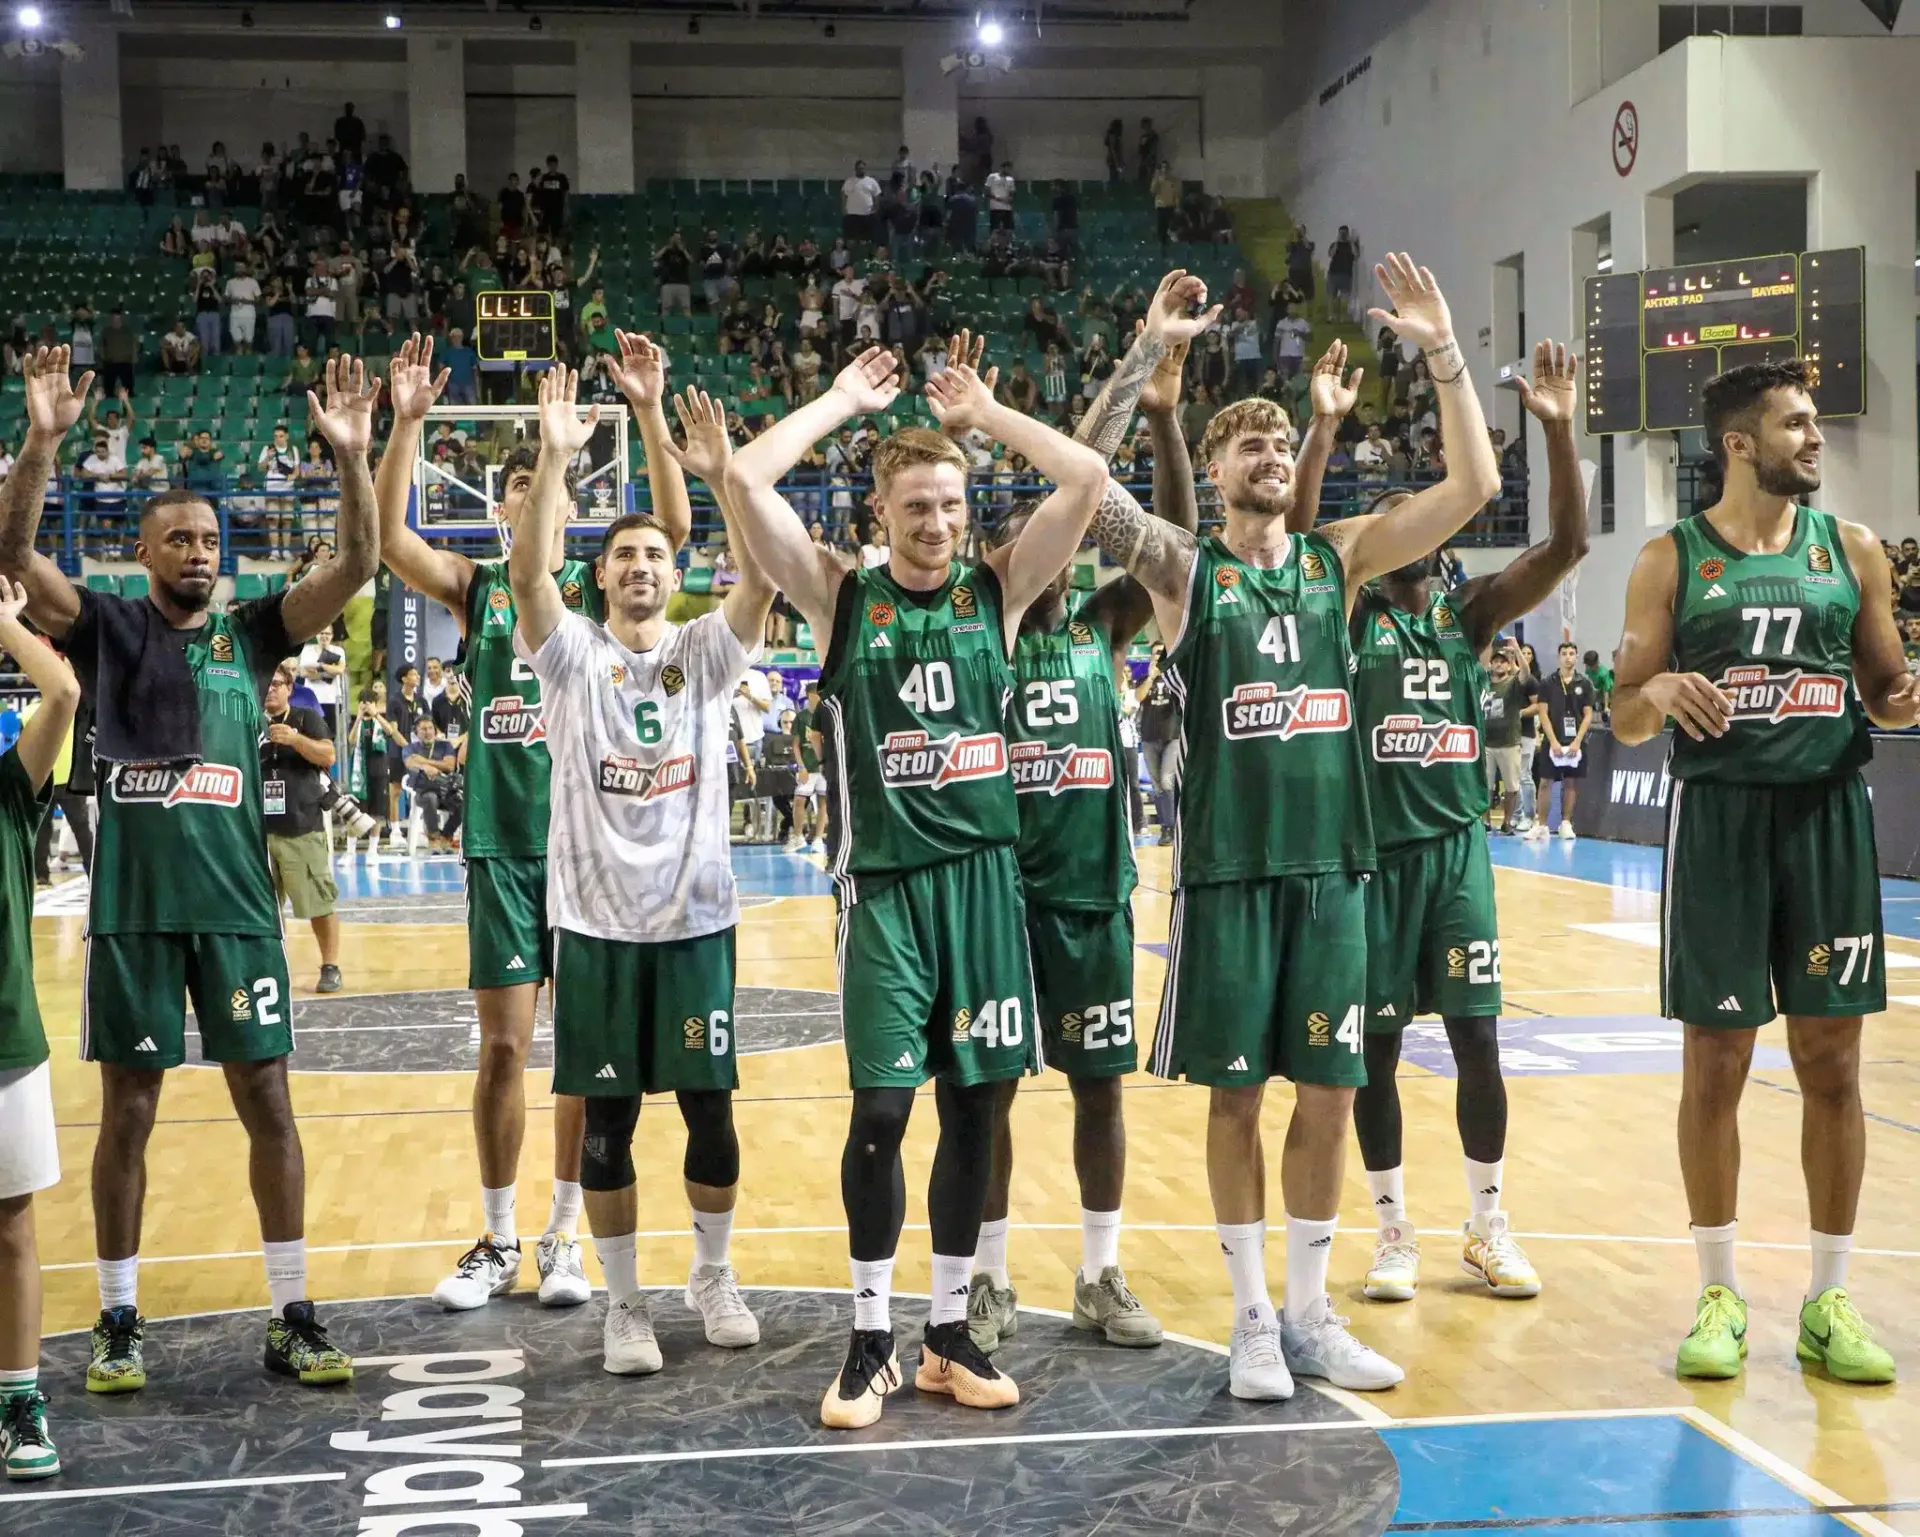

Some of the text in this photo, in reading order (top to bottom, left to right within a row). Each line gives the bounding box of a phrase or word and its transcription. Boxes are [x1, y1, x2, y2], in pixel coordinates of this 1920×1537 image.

[1644, 294, 1703, 309] AKTOR PAO
[1751, 284, 1794, 298] BAYERN
[1702, 327, 1736, 339] Bodet
[951, 623, 985, 634] oneteam
[1256, 614, 1301, 664] 41
[1741, 608, 1803, 656] 77
[898, 661, 956, 713] 40
[1240, 686, 1269, 702] pame
[1403, 657, 1451, 700] 22
[1730, 669, 1761, 683] pame
[495, 701, 518, 712] pame
[634, 700, 663, 744] 6
[1025, 679, 1079, 727] 25
[1388, 719, 1416, 730] pame
[891, 734, 922, 751] pame
[1012, 745, 1041, 760] pame
[1834, 932, 1874, 985] 77
[252, 976, 281, 1026] 2
[969, 997, 1023, 1048] 40
[709, 1009, 729, 1056] 6
[1083, 998, 1133, 1050] 25
